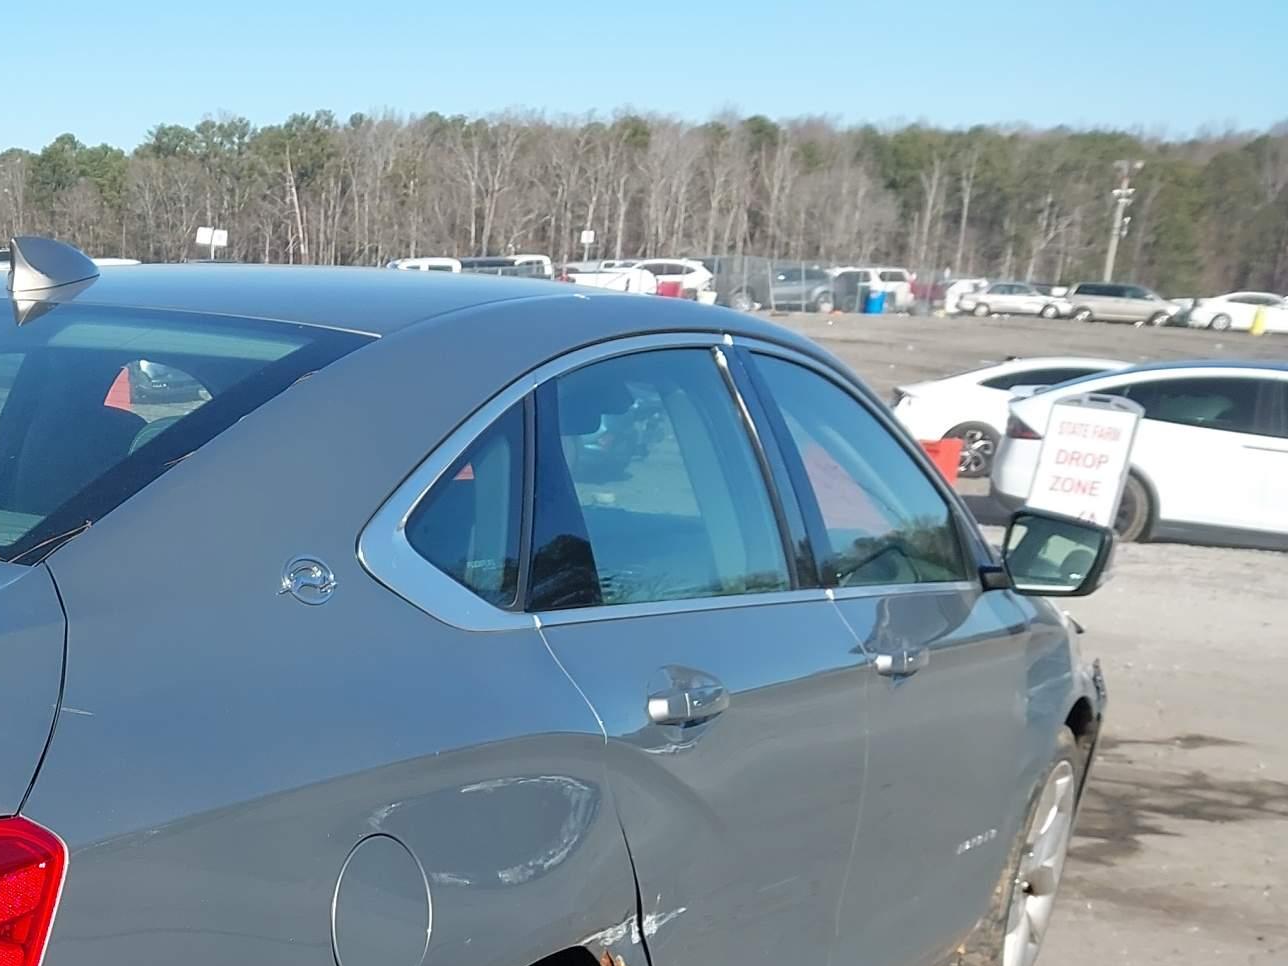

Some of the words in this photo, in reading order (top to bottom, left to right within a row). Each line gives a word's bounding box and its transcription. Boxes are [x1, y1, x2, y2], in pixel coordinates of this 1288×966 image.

[1057, 420, 1090, 437] STATE
[1092, 424, 1124, 442] FARM
[1055, 448, 1110, 470] DROP
[1048, 475, 1103, 498] ZONE
